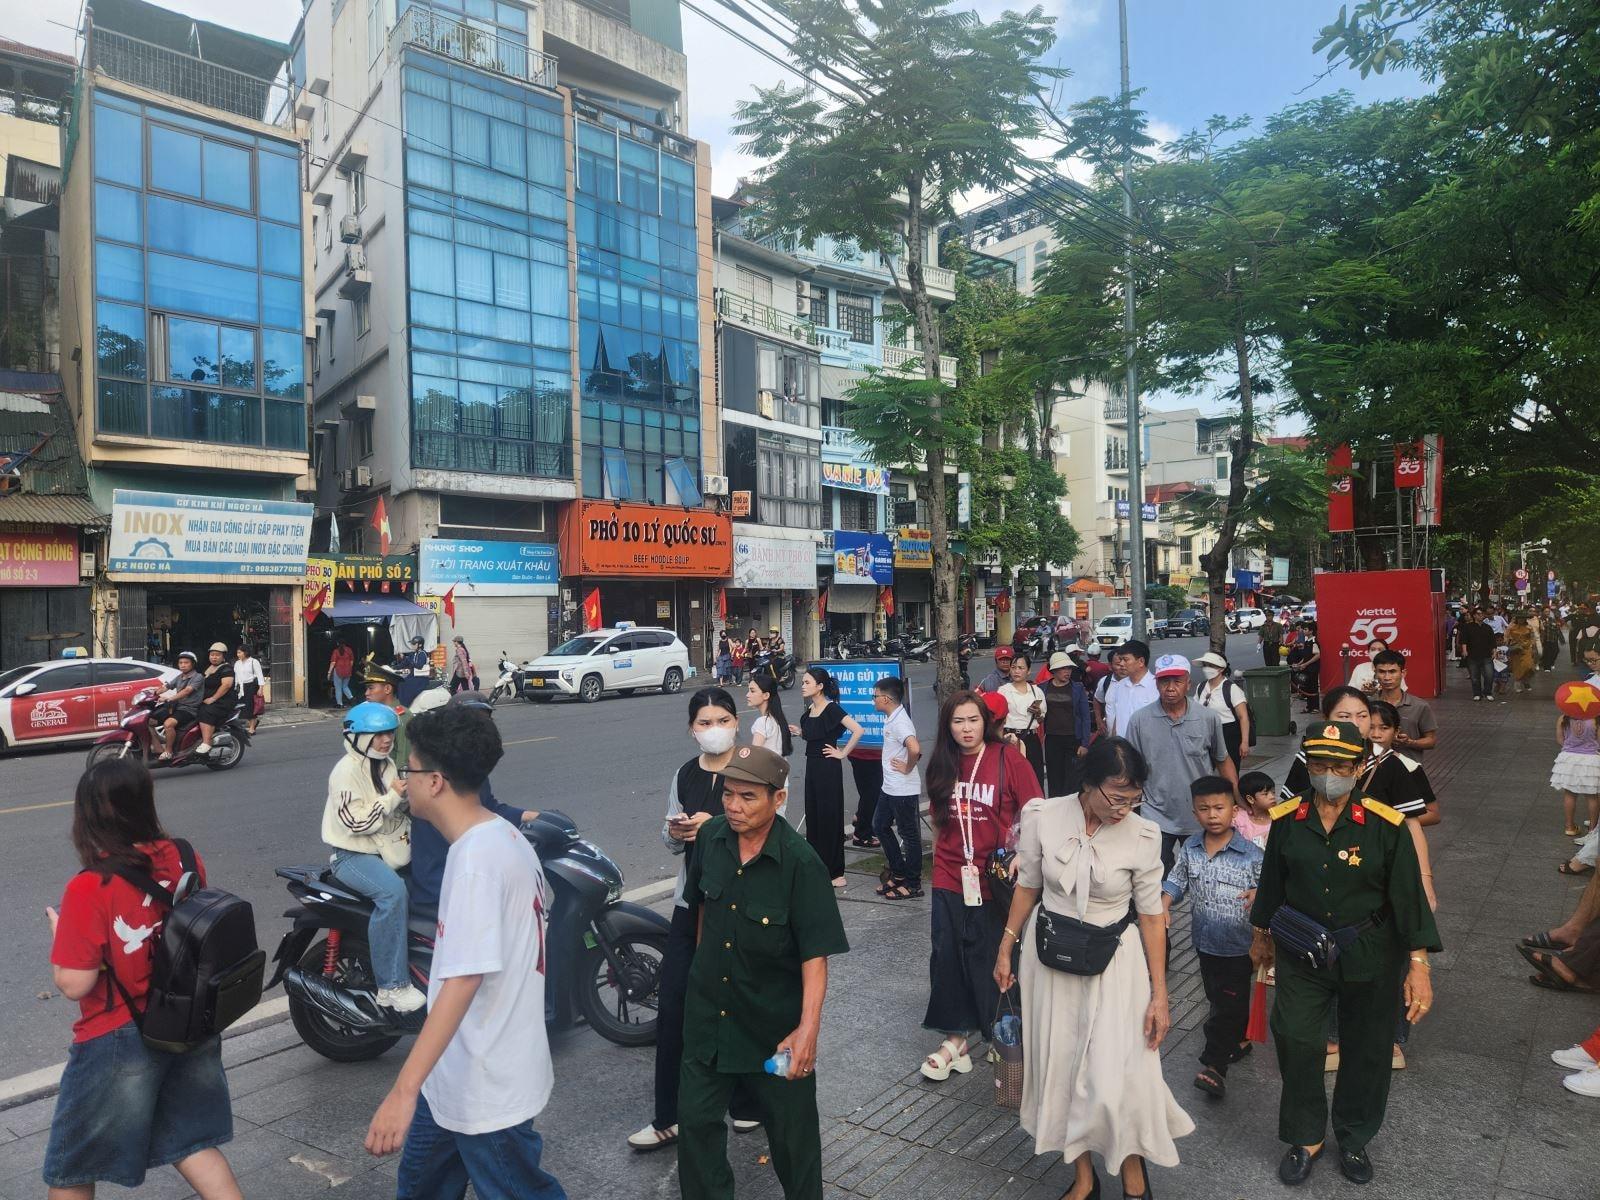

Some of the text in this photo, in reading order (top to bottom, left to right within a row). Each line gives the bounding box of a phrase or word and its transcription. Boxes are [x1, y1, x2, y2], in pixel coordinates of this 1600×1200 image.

[123, 511, 184, 535] INOX
[210, 520, 221, 533] GIA
[589, 512, 619, 541] PHỞ
[622, 521, 640, 542] 10
[643, 518, 661, 543] LÝ
[663, 518, 698, 548] QUỐC
[700, 525, 718, 546] SƯ
[13, 540, 42, 565] CỘNG
[45, 538, 73, 561] ĐỒNG
[184, 540, 201, 552] MUA
[251, 542, 266, 554] INOX
[458, 545, 484, 553] SHOP
[738, 544, 749, 555] 66
[130, 561, 156, 571] NGỌC
[158, 561, 171, 571] HÀ
[430, 556, 551, 572] THỜI TRANG XUẤT KHẨU
[633, 555, 689, 565] BEEF NOODLE SOUP
[13, 564, 24, 580] SỐ
[25, 568, 38, 580] 2-3
[360, 562, 383, 579] PHỐ
[386, 562, 402, 579] SỐ
[404, 566, 412, 579] 2
[1356, 607, 1397, 616] viettel
[1349, 617, 1399, 646] 5G
[1339, 648, 1364, 657] CỘC
[837, 669, 855, 682] VÀO
[857, 668, 874, 682] GỬI
[857, 687, 867, 695] XE
[31, 718, 68, 728] GENERALI
